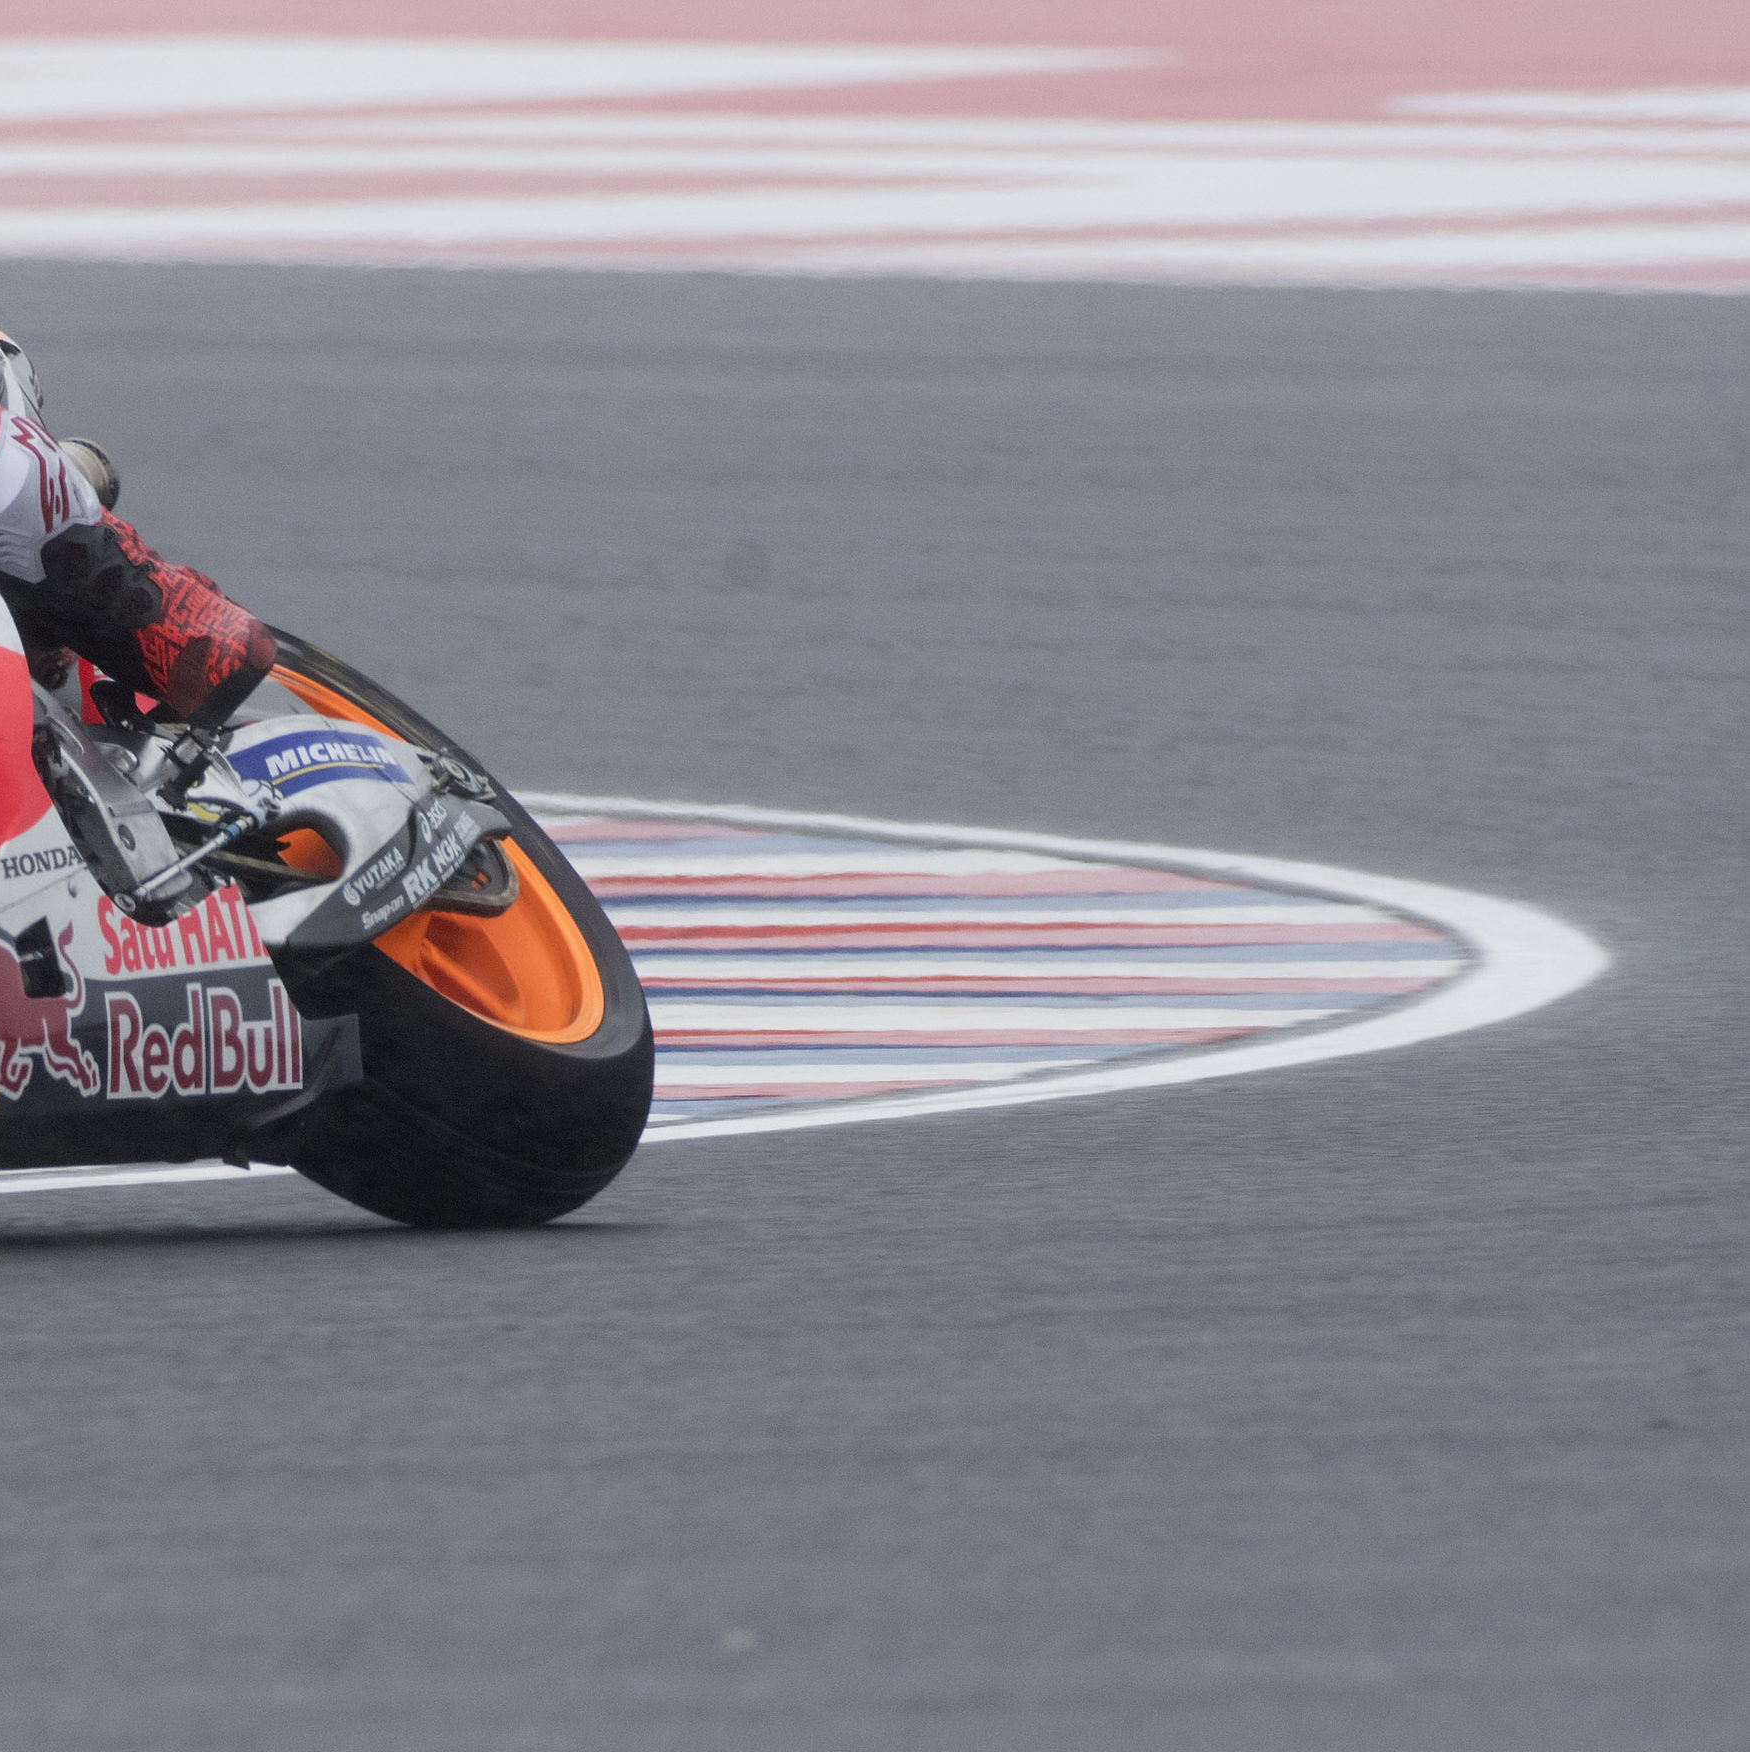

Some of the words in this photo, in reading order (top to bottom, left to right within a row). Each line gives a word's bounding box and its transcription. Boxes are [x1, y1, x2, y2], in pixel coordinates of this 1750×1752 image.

[266, 742, 398, 778] MICHELIN
[0, 845, 84, 879] HONDA
[353, 847, 404, 895] YUTAKA
[431, 832, 465, 874] NGK
[402, 857, 437, 903] RK
[98, 894, 176, 975] Satu
[105, 983, 205, 1100] Red
[207, 979, 303, 1095] Bull
